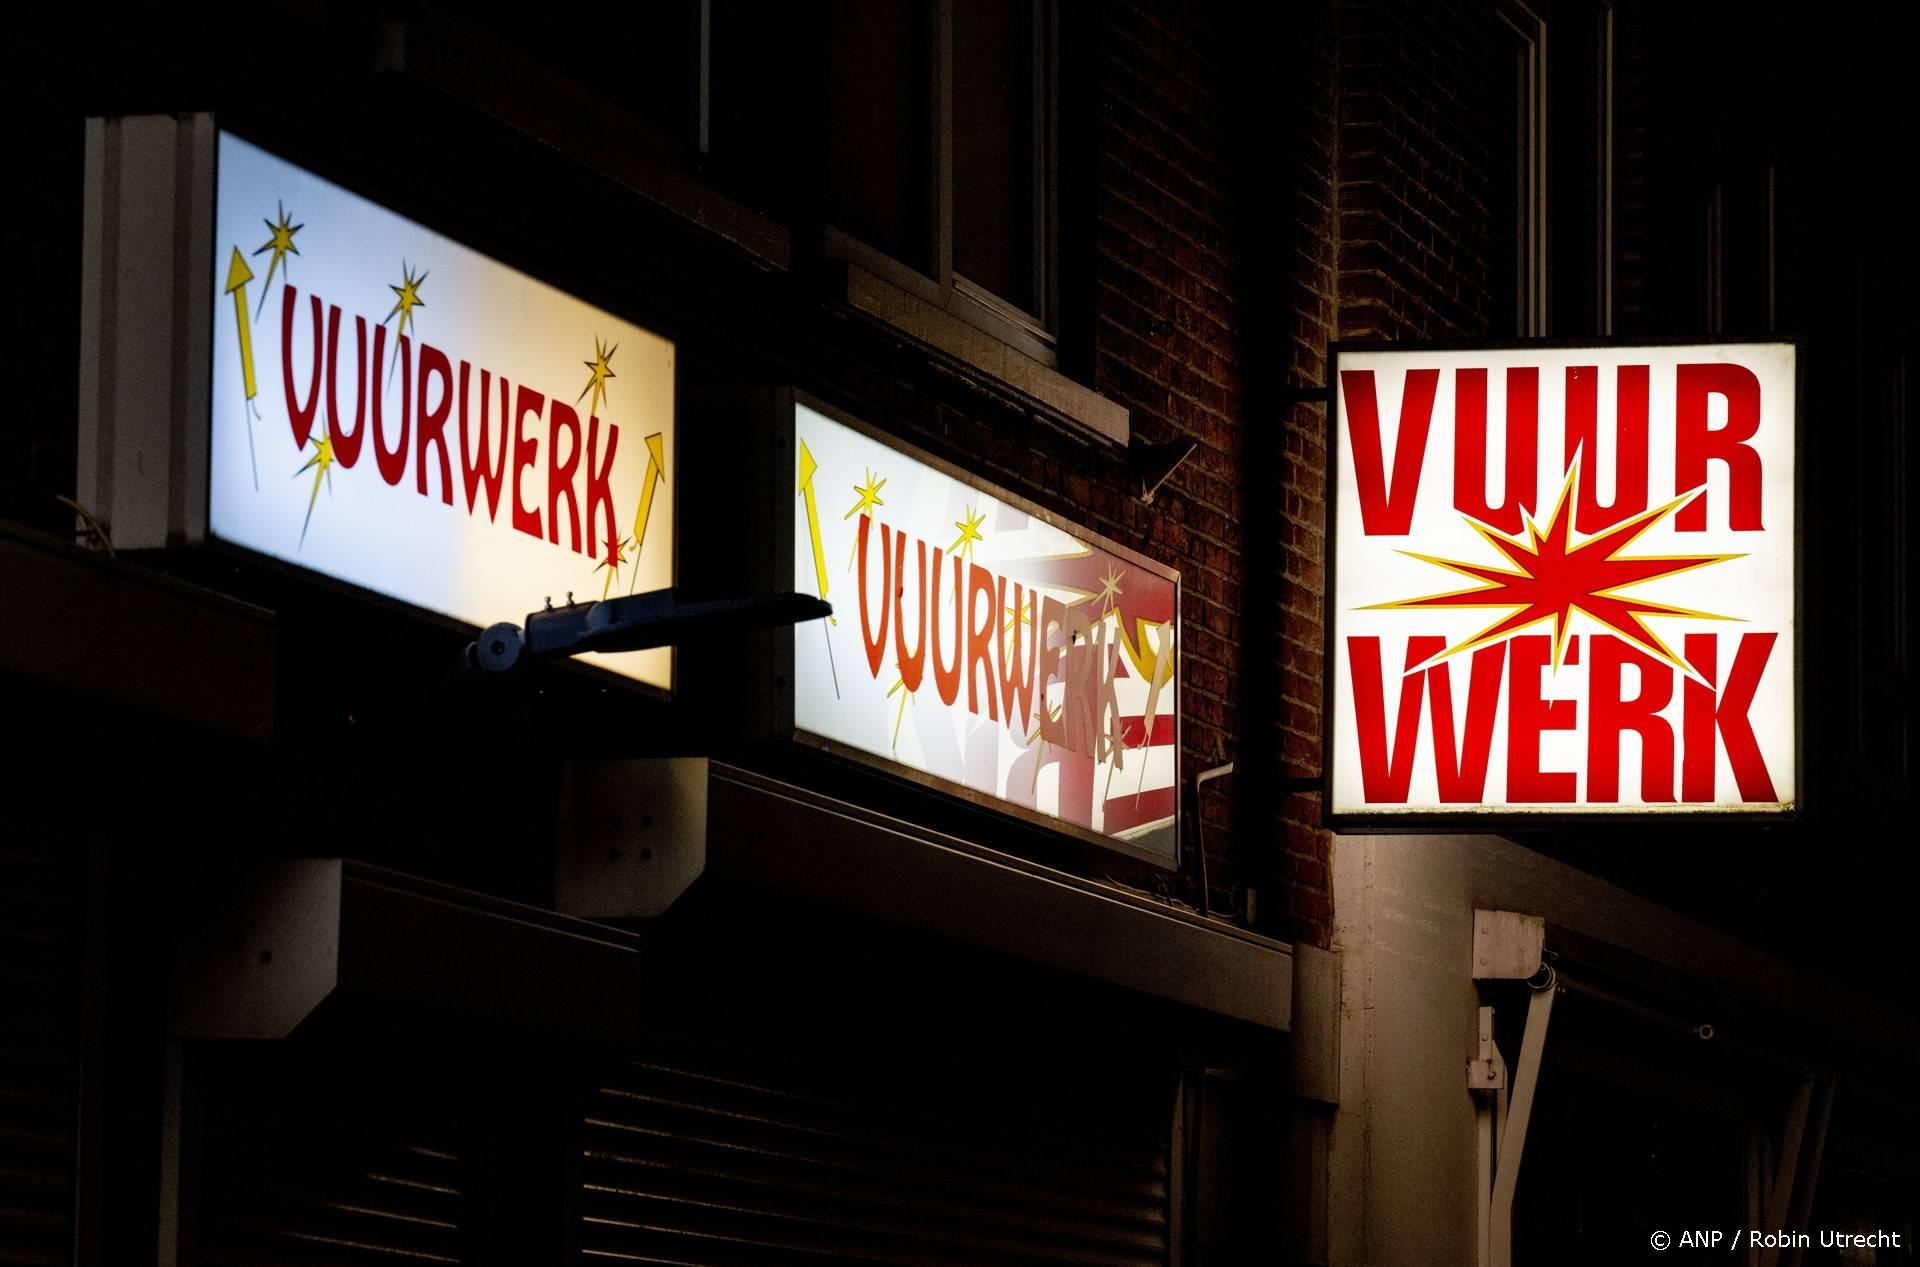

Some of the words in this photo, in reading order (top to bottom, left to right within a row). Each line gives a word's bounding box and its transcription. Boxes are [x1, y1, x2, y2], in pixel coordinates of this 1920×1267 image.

[281, 284, 620, 568] VUURWERK
[1340, 363, 1766, 536] VUUR
[857, 513, 1124, 771] VUURWERK
[1347, 632, 1779, 804] WERK
